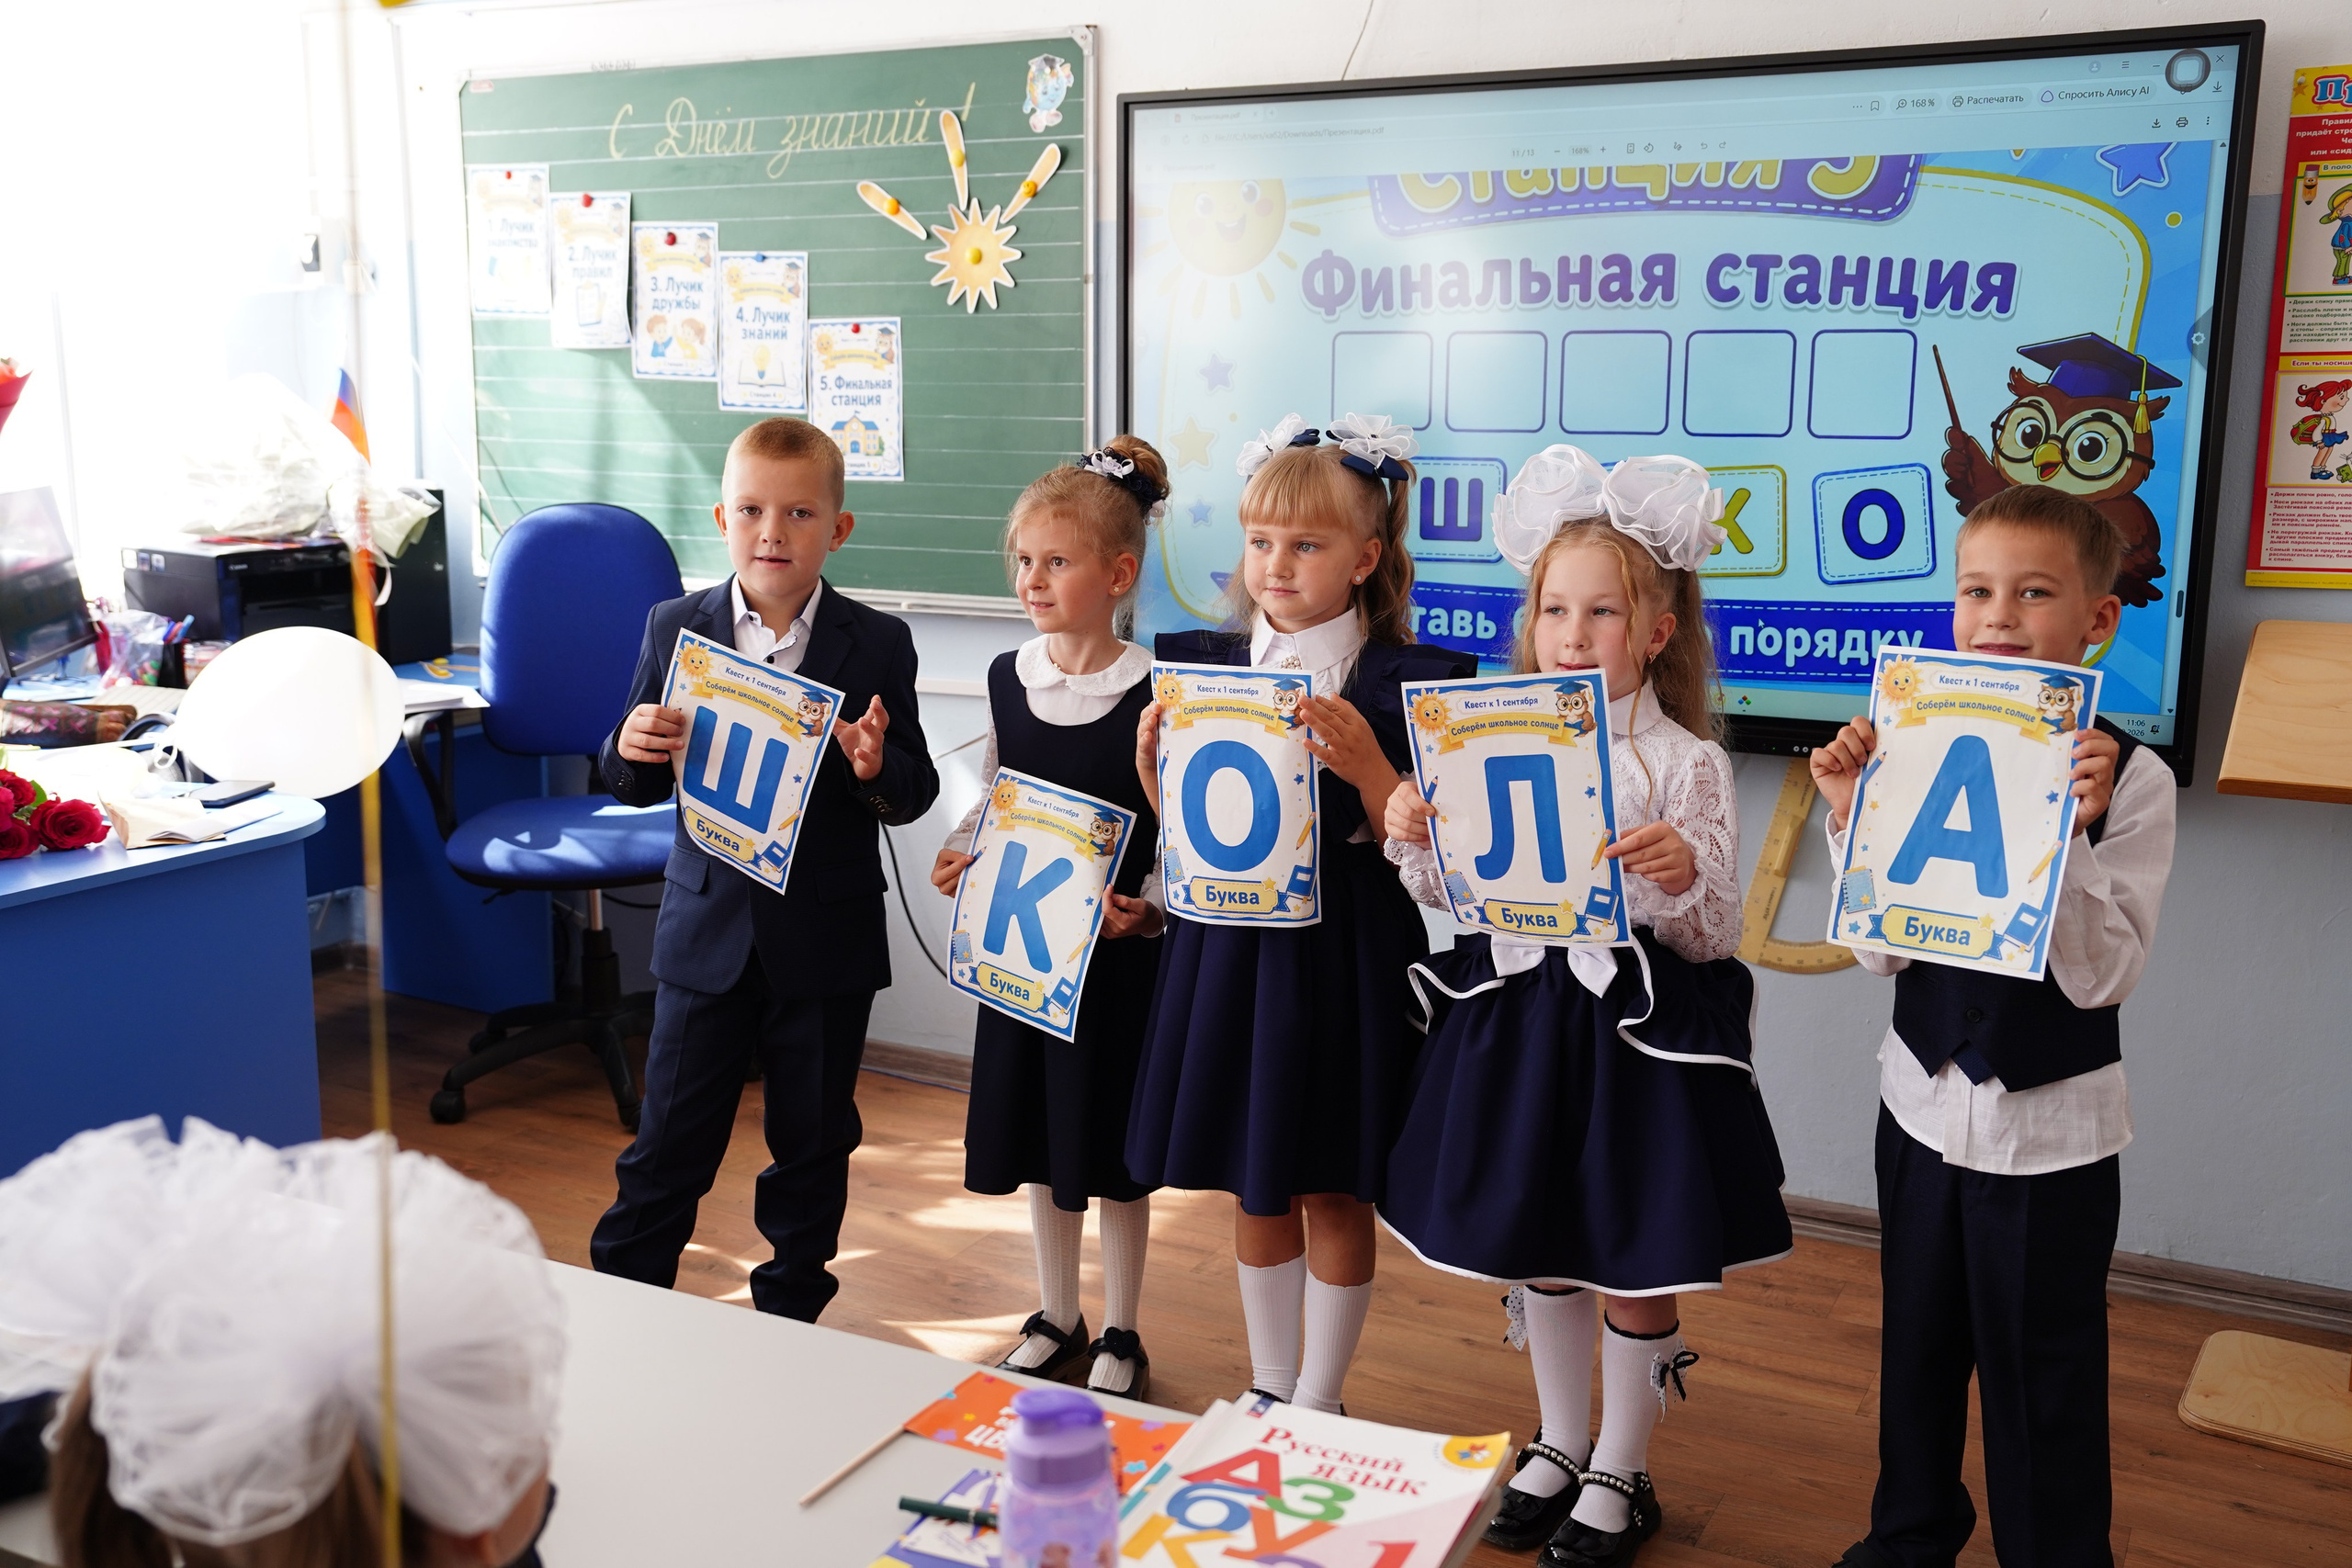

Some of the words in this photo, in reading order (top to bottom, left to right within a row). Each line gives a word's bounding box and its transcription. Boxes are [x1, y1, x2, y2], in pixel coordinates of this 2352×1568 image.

[1911, 98, 1927, 108] 168
[1967, 94, 2024, 105] Распечатать
[2058, 88, 2105, 101] Спросить
[2107, 85, 2137, 98] Алису
[2139, 86, 2150, 96] AI
[2314, 75, 2352, 107] П
[608, 103, 634, 160] С
[654, 96, 759, 158] Днём
[2296, 129, 2333, 138] придаёт
[499, 218, 536, 235] Лучик
[582, 247, 617, 265] Лучик
[572, 266, 613, 280] правил
[1301, 249, 1679, 318] Финальная
[1704, 252, 2018, 320] станция
[650, 276, 662, 292] 3.
[665, 277, 704, 296] Лучик
[652, 297, 701, 313] дружбы
[736, 307, 749, 322] 4.
[752, 307, 790, 326] Лучик
[741, 324, 788, 340] знаний
[820, 376, 832, 391] 5.
[834, 375, 893, 391] Финальная
[831, 393, 882, 407] станция
[1419, 477, 1484, 542] Ш
[1841, 487, 1906, 560] О
[1410, 605, 1498, 640] тавь
[725, 667, 744, 681] Квест
[757, 679, 786, 696] сентября
[1197, 684, 1217, 694] Квест
[1223, 685, 1227, 694] 1
[1228, 686, 1259, 696] сентября
[1939, 674, 1963, 687] Квест
[1965, 679, 1972, 687] к
[1973, 678, 1978, 688] 1
[1980, 679, 2020, 692] сентября
[706, 680, 736, 695] Соберём
[738, 689, 771, 709] школьное
[772, 705, 795, 723] солнце
[1183, 705, 1214, 716] Соберём
[1216, 705, 1249, 715] школьное
[1250, 709, 1275, 721] солнце
[1464, 700, 1487, 710] Квест
[1496, 698, 1500, 707] 1
[1502, 696, 1539, 707] сентября
[1917, 699, 1956, 712] Соберём
[1958, 700, 2003, 713] школьное
[2005, 706, 2037, 724] солнце
[1451, 720, 1487, 737] Соберём
[1488, 718, 1529, 729] школьное
[1530, 718, 1560, 731] солнце
[683, 705, 790, 835] Ш
[1027, 795, 1044, 807] Квест
[1054, 805, 1080, 819] сентября
[1182, 739, 1282, 873] О
[1886, 734, 2009, 899] А
[1010, 811, 1035, 823] Соберём
[1036, 817, 1066, 833] школьное
[1066, 829, 1088, 844] солнце
[1474, 753, 1567, 884] Л
[695, 818, 741, 852] Буква
[982, 840, 1075, 975] К
[1205, 885, 1261, 906] Буква
[1501, 907, 1558, 928] Буква
[1904, 916, 1972, 946] Буква
[989, 972, 1030, 1002] Буква
[1258, 1426, 1406, 1473] Русский
[1307, 1462, 1429, 1496] язык
